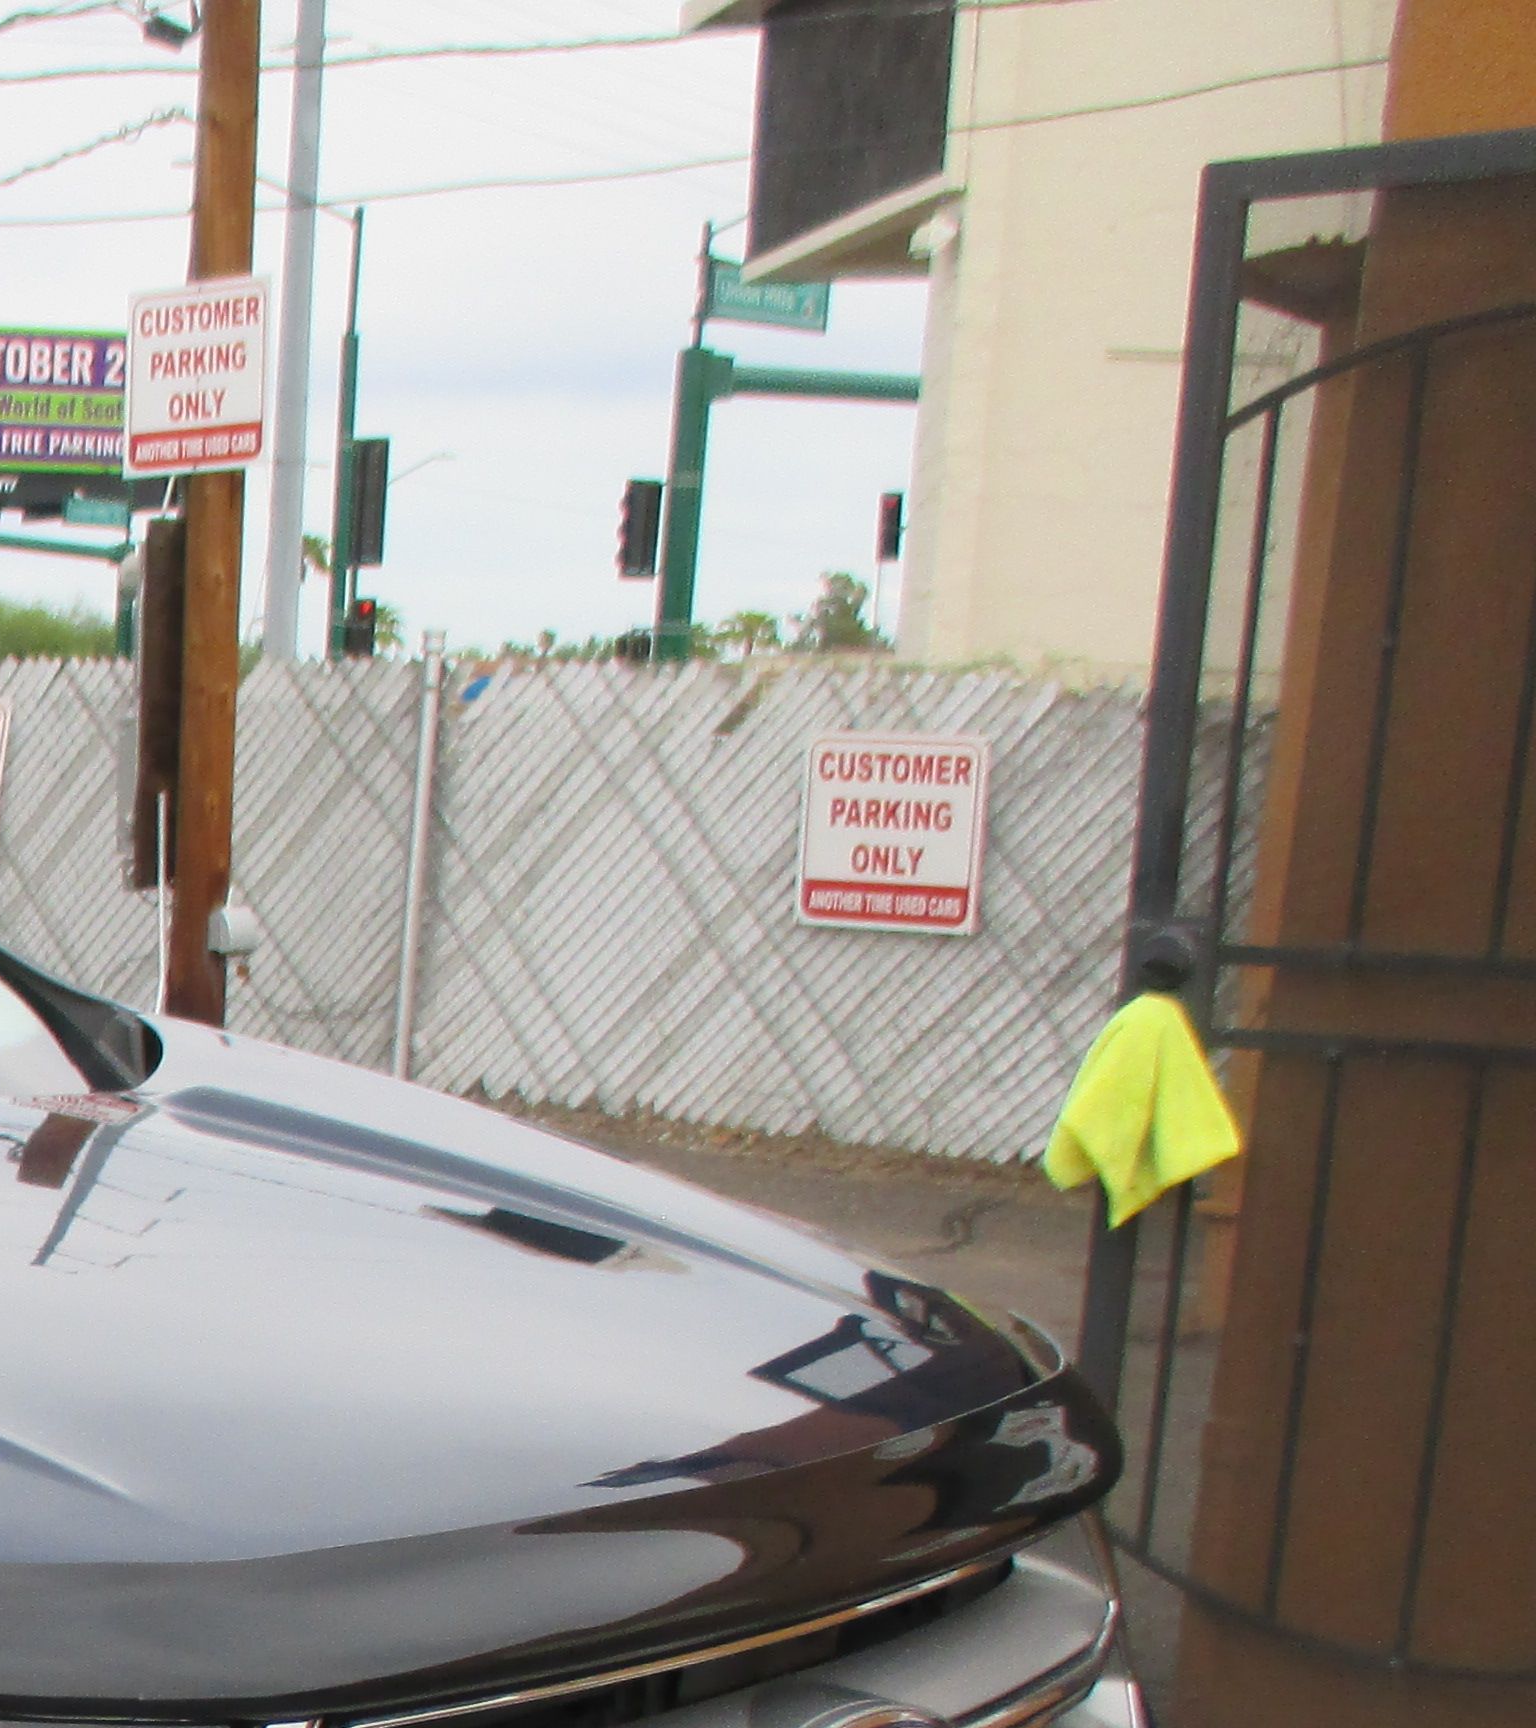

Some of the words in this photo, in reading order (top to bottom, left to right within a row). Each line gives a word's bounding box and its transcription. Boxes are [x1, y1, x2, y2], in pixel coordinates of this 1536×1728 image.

[140, 297, 260, 338] CUSTOMER
[150, 341, 247, 381] PARKING
[168, 389, 226, 422] ONLY
[0, 428, 45, 454] FREE
[818, 751, 971, 786] CUSTOMER
[829, 797, 953, 832] PARKING
[851, 843, 925, 876] ONLY
